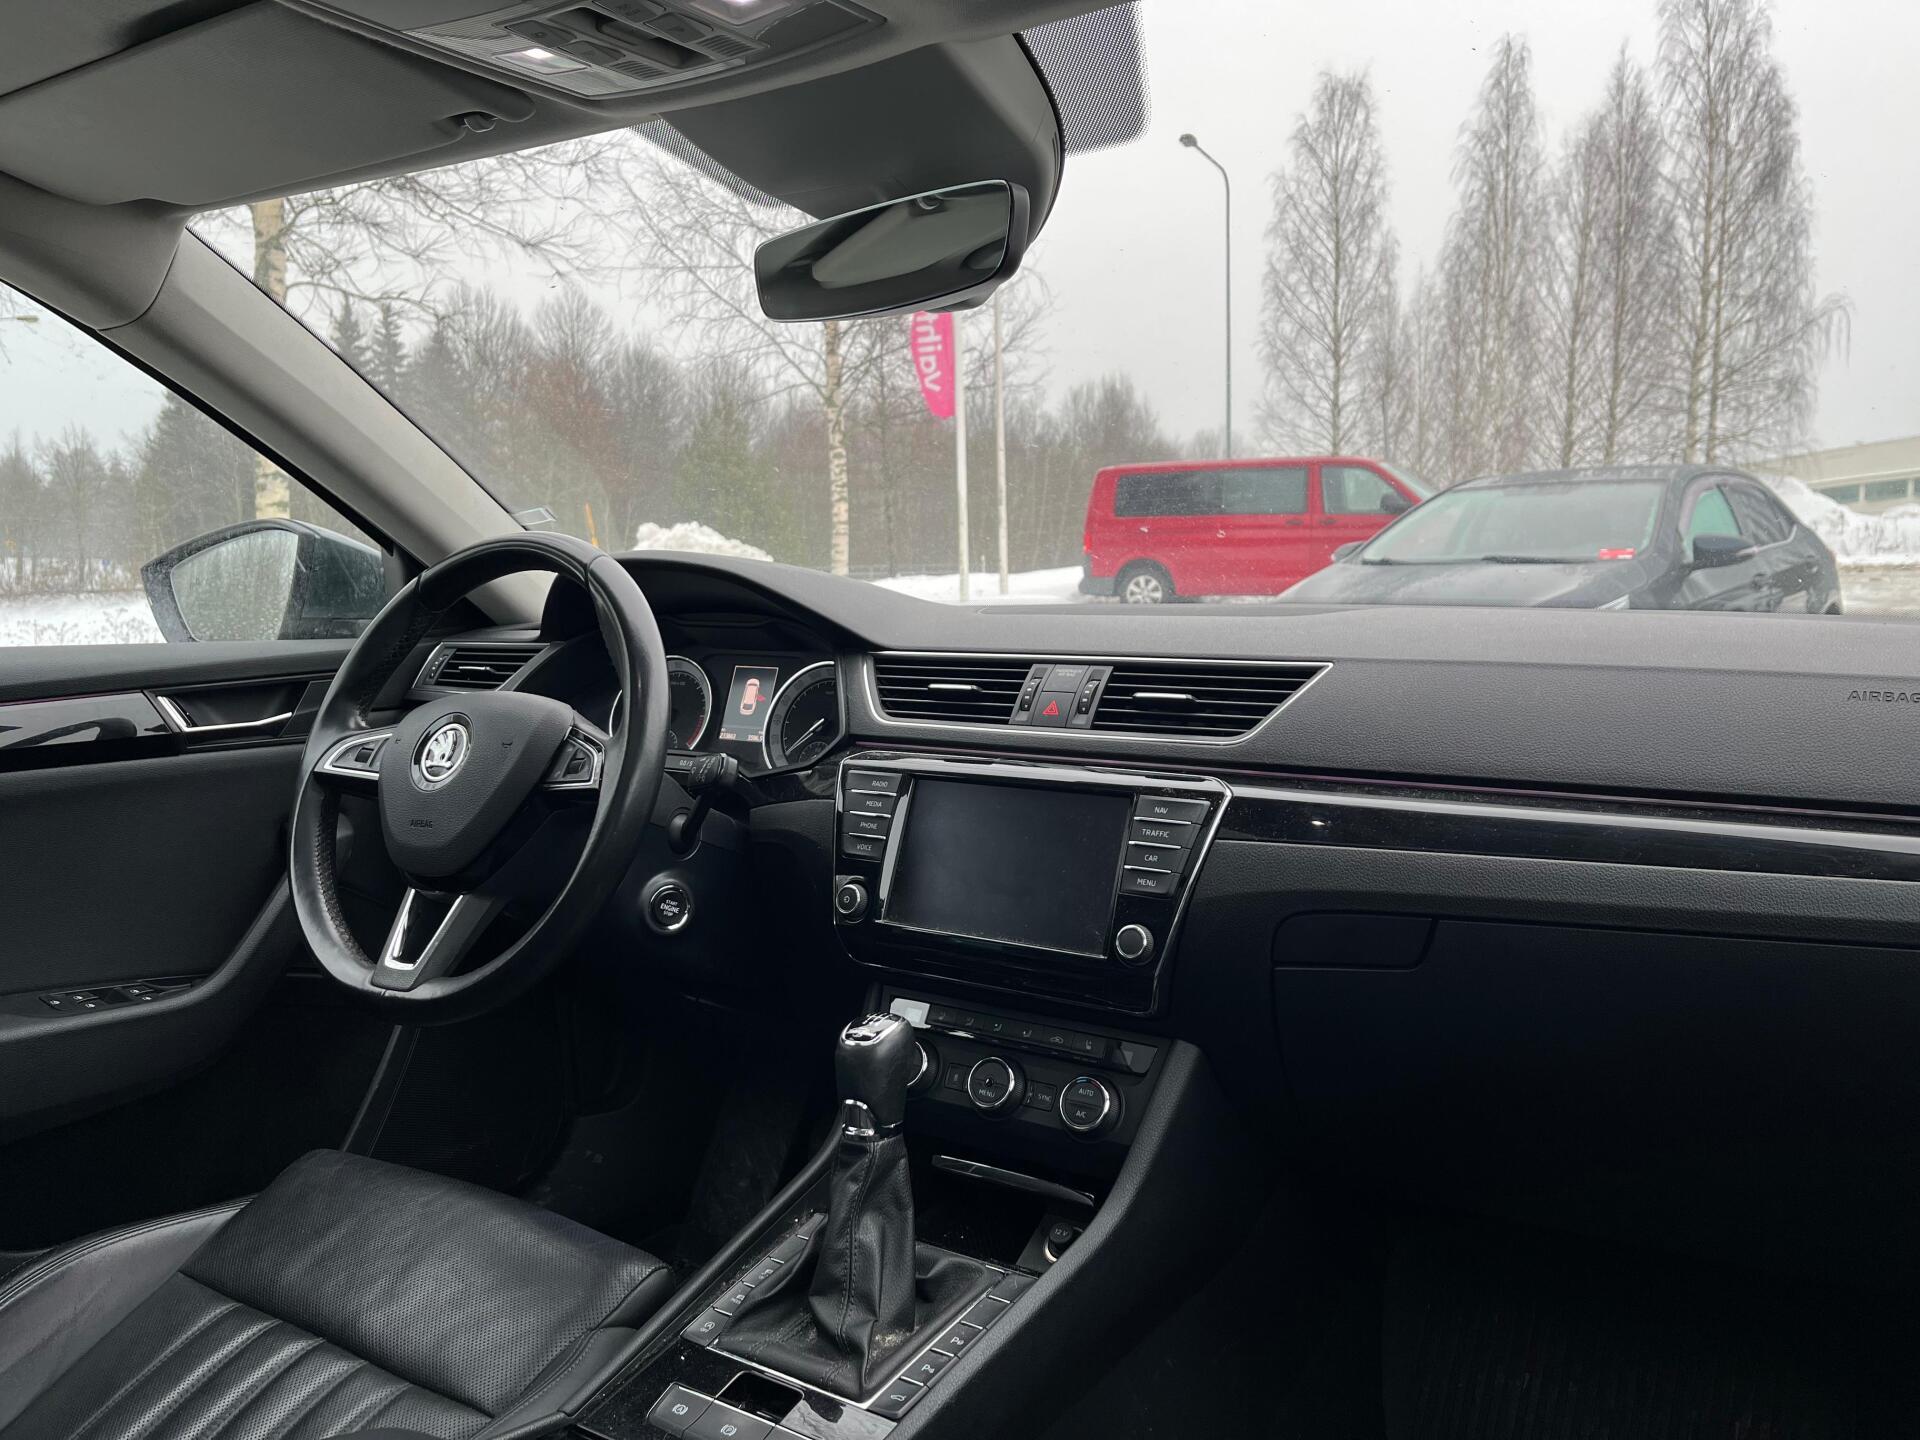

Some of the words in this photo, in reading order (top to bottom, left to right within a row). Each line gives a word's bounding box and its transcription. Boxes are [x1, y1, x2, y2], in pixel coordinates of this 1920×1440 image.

[1847, 690, 1920, 703] AIRBAG
[871, 780, 889, 788] RADIO
[865, 800, 882, 808] MEDIA
[1154, 806, 1169, 814] NAV
[860, 821, 878, 830] PHONE
[1142, 828, 1170, 838] TRAFFIC
[856, 843, 873, 851] VOICE
[1144, 854, 1159, 862] CAR
[1136, 877, 1157, 887] MENU
[978, 1088, 996, 1098] MENU
[1078, 1087, 1094, 1097] AUTO
[1075, 1109, 1087, 1119] A/C
